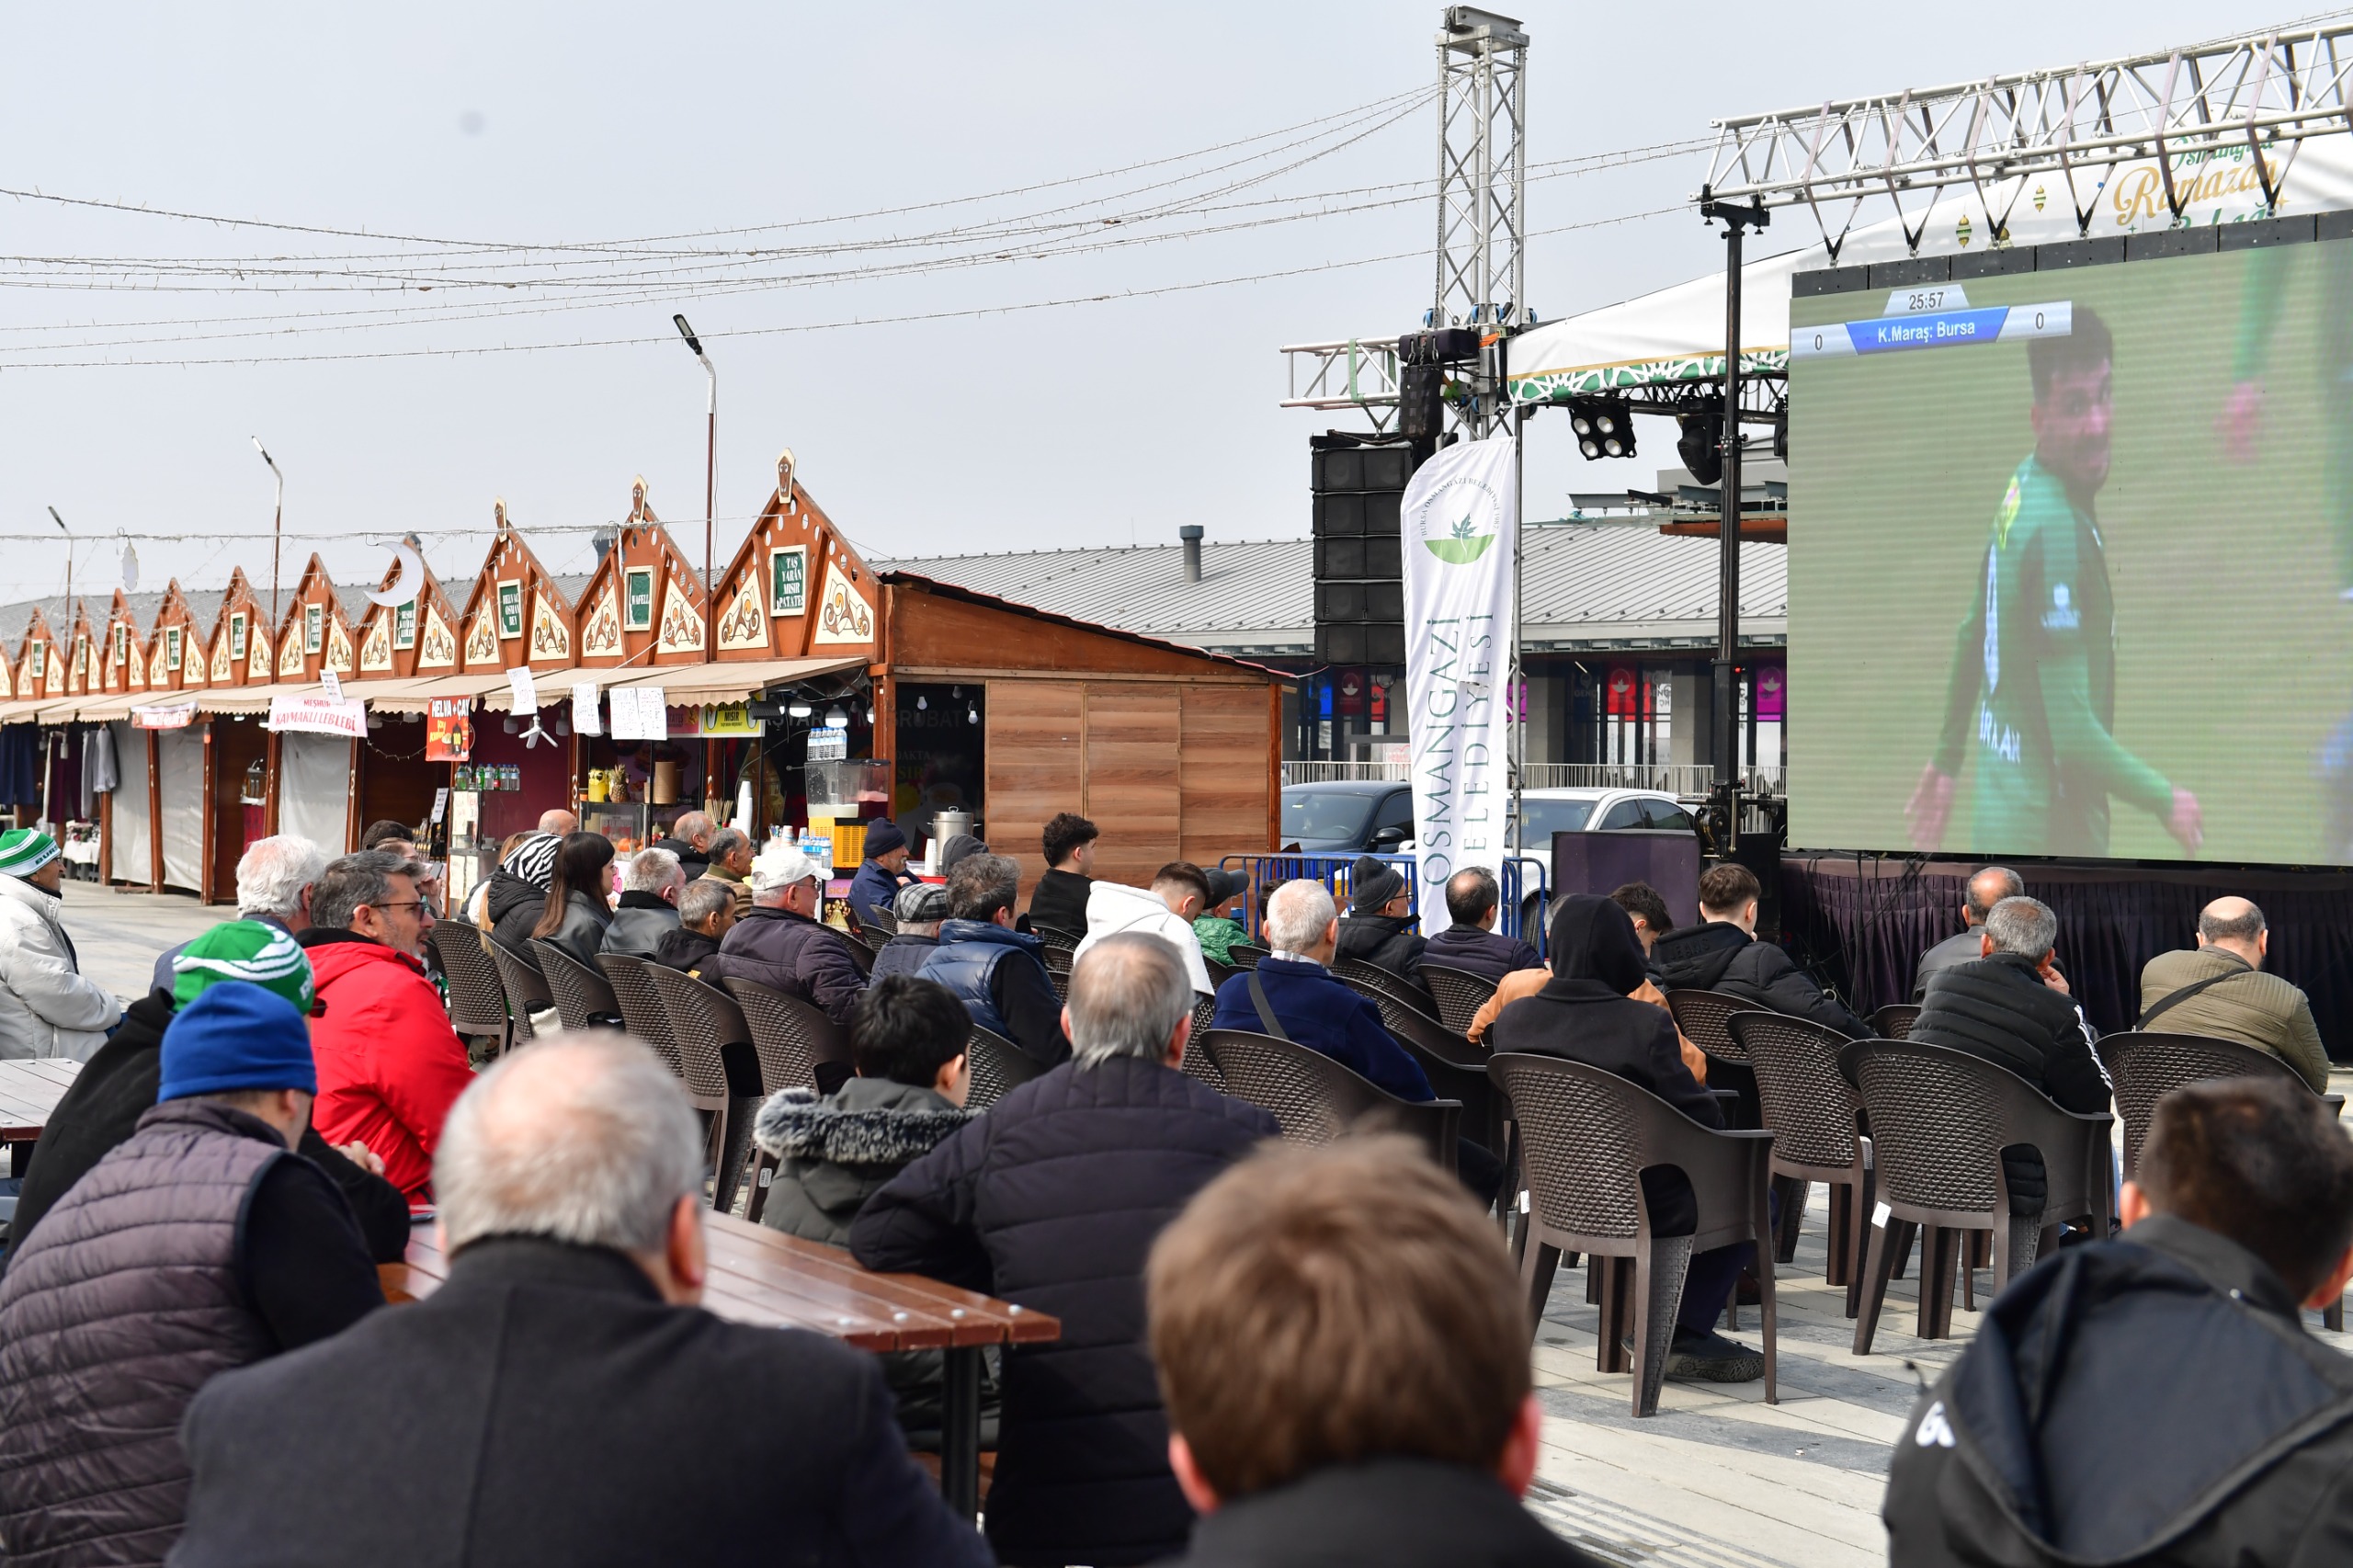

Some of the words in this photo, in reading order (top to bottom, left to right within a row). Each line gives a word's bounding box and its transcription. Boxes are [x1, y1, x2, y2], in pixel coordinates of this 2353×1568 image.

[2114, 159, 2279, 227] Ramazan
[1908, 291, 1944, 311] 25:57
[2036, 312, 2045, 330] 0
[1814, 334, 1824, 351] 0
[1878, 324, 1933, 344] K.Maraş:
[1937, 322, 1975, 338] Bursa
[1420, 509, 1428, 536] BURSA
[783, 582, 801, 596] MISIR
[432, 699, 452, 718] HELVA
[723, 711, 740, 722] MISIR
[276, 711, 317, 726] KAYMAKLI
[319, 712, 356, 732] LEBLEBİ
[1461, 614, 1494, 851] ELEDİYESİ
[1423, 617, 1461, 886] OSMANGAZİ
[826, 886, 851, 895] SICA
